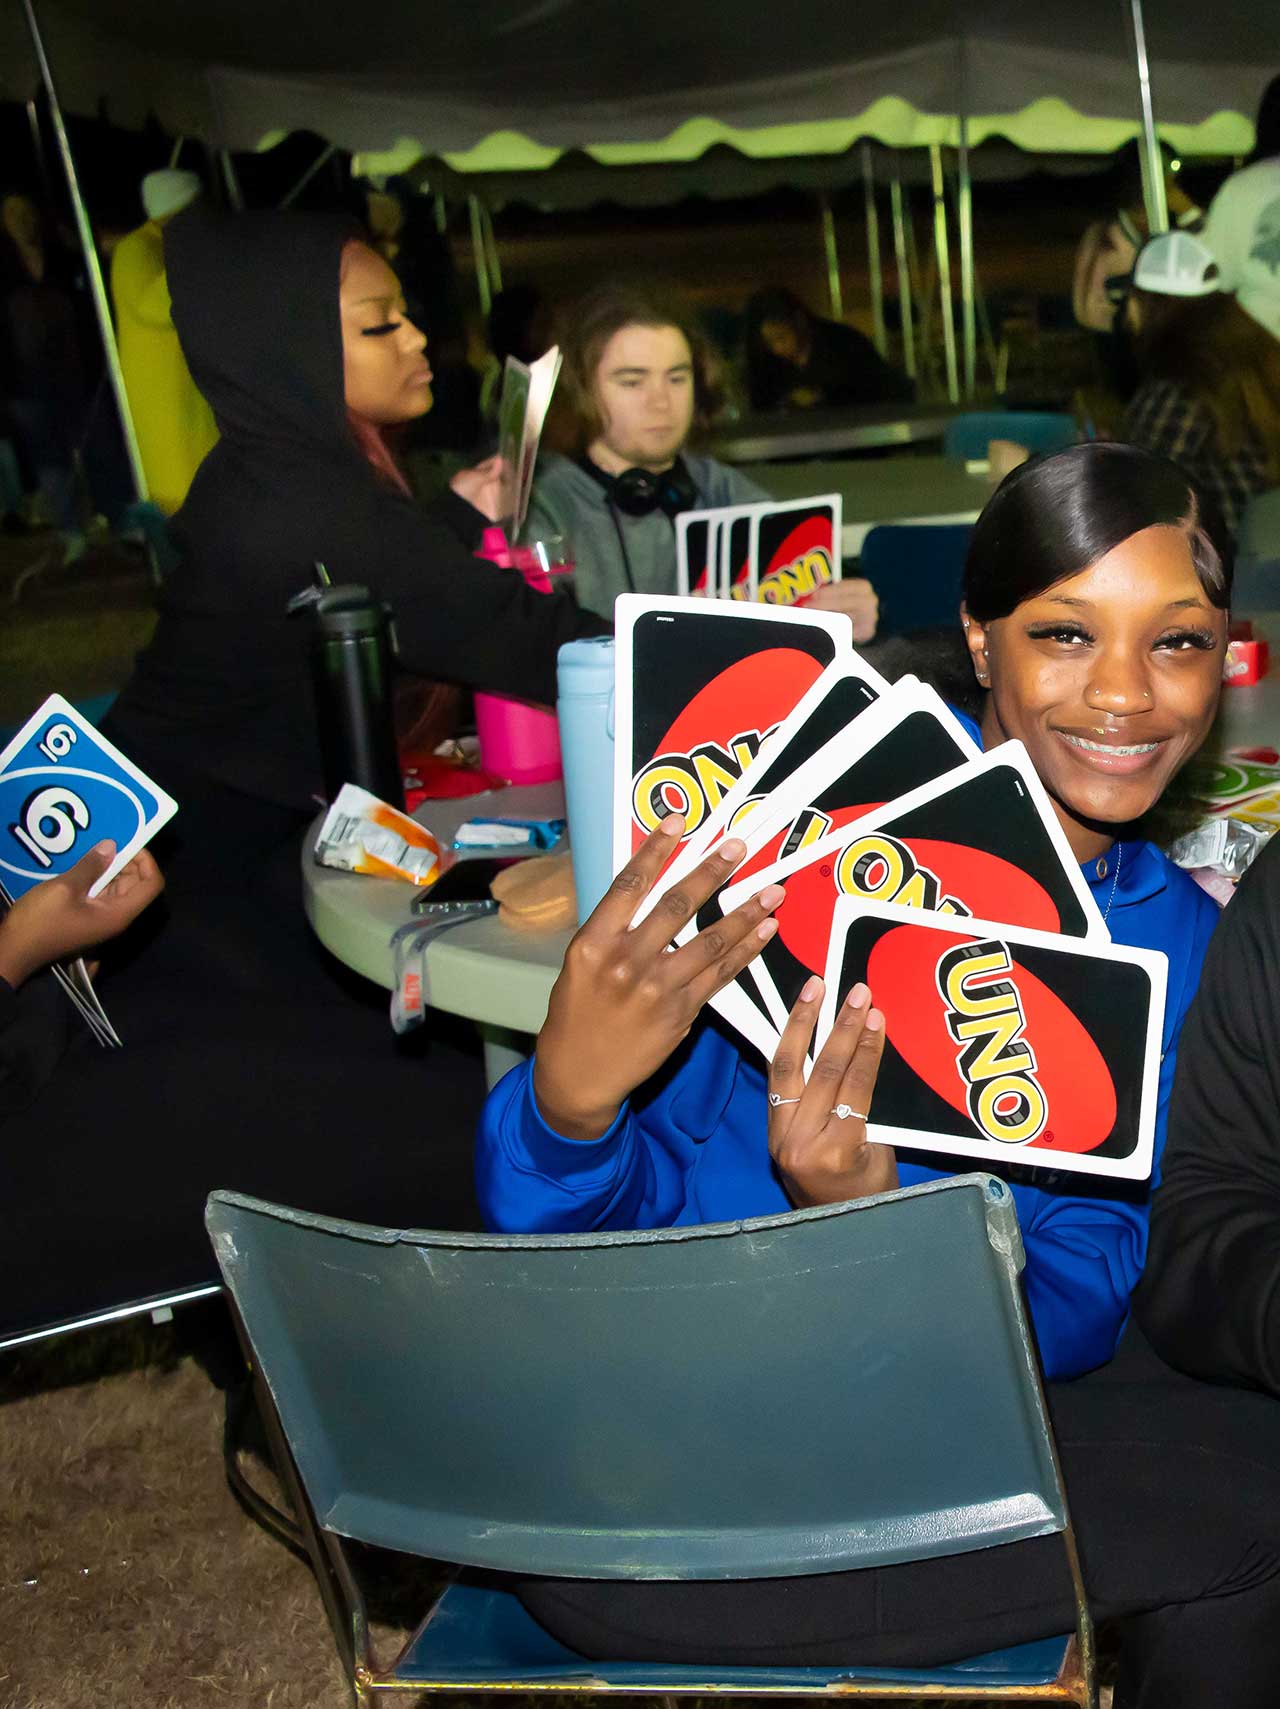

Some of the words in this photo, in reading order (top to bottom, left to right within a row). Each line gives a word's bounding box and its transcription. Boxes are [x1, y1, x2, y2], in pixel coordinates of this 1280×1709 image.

[39, 723, 77, 762] 6
[14, 786, 89, 867] 6
[936, 939, 1048, 1145] UNO
